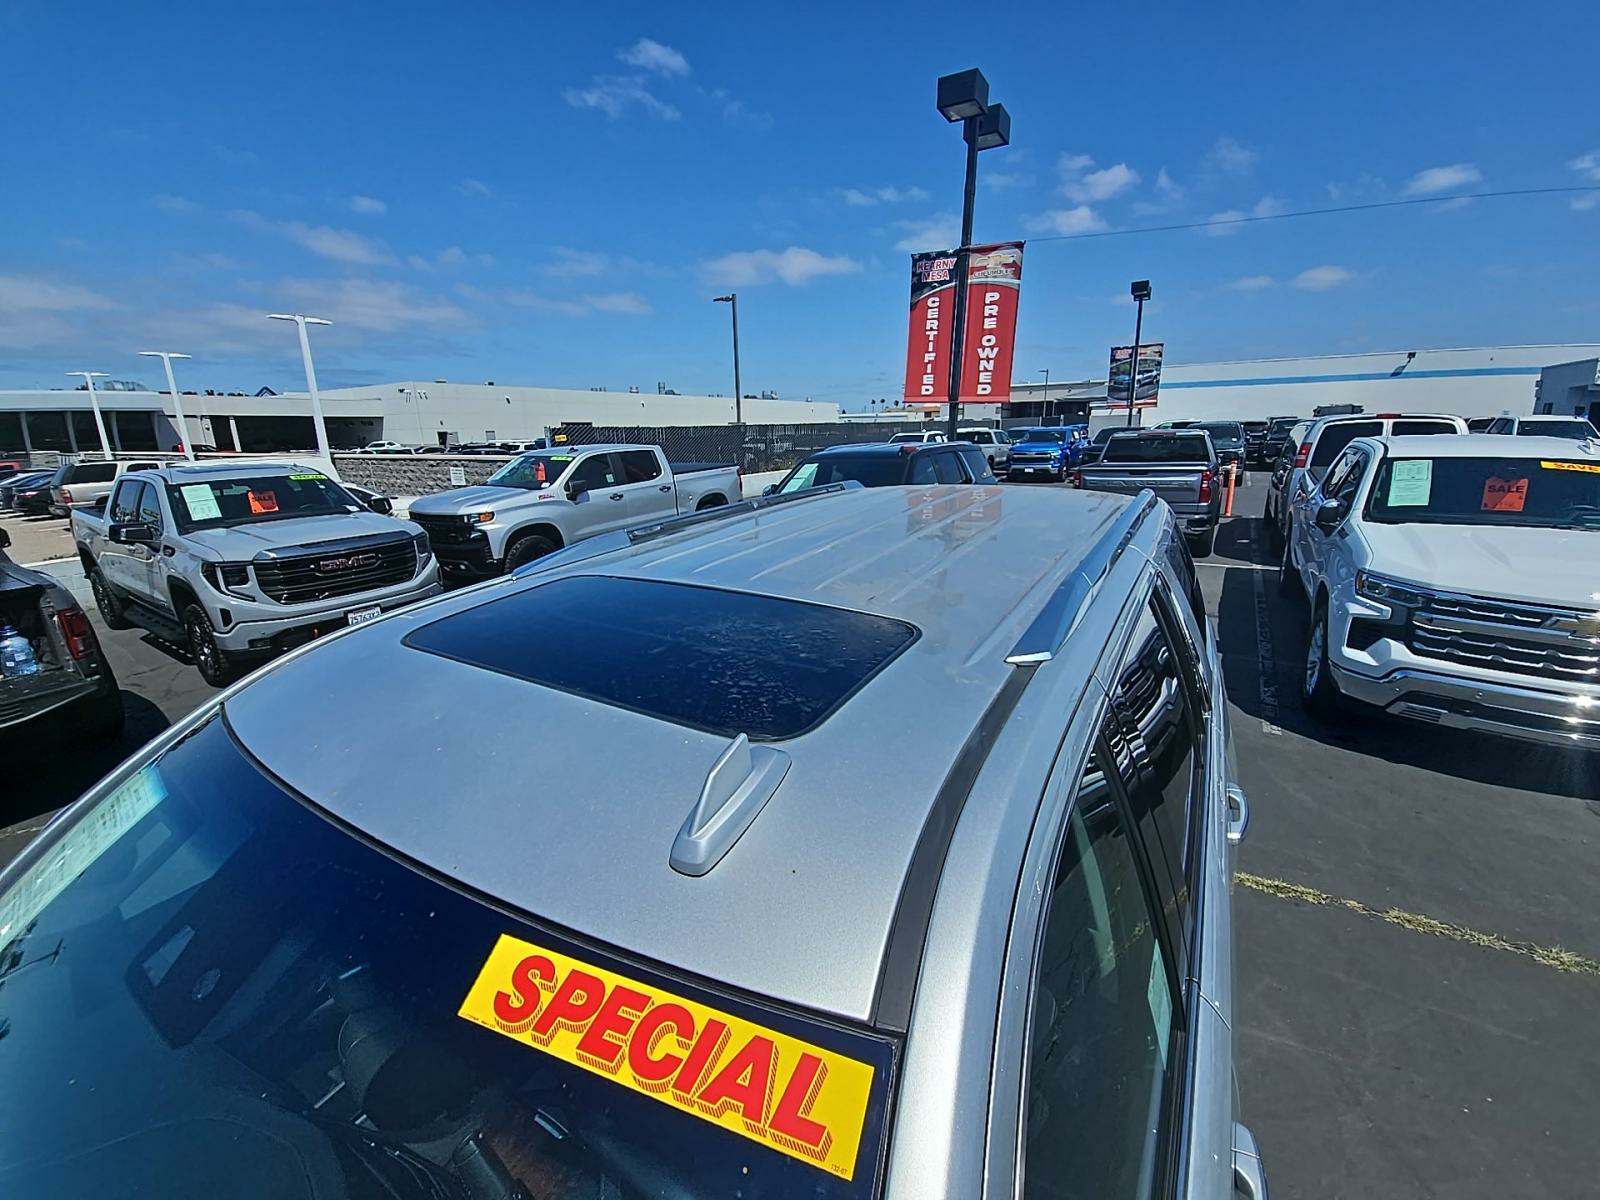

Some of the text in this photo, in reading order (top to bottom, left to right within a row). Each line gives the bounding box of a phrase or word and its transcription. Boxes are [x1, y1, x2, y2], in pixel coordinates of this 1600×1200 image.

[916, 257, 957, 273] KEARNY
[922, 269, 950, 282] MESA
[921, 296, 940, 395] CERTIFIED
[976, 292, 1000, 395] PRE OWNED
[1487, 484, 1526, 493] SALE
[493, 954, 833, 1162] SPECIAL
